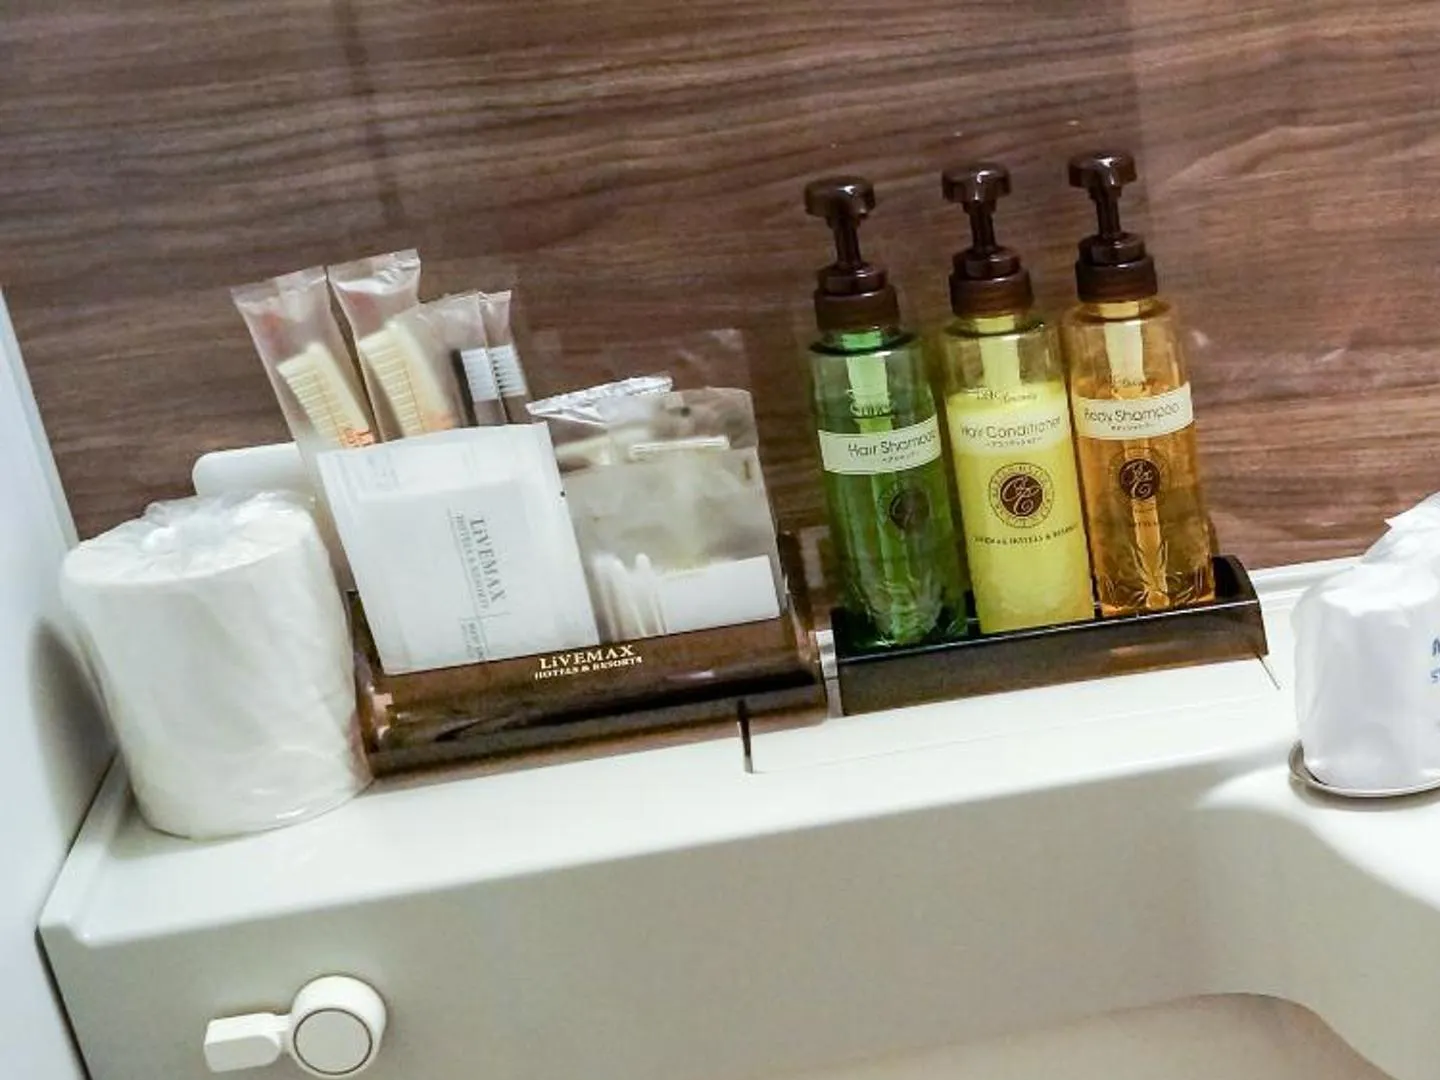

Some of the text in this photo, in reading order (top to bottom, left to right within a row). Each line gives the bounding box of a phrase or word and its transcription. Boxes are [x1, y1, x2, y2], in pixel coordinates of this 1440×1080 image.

[847, 442, 877, 457] Hair
[534, 665, 580, 681] HOTELS
[592, 656, 642, 671] RESORTS
[540, 645, 635, 670] LiVEMAX
